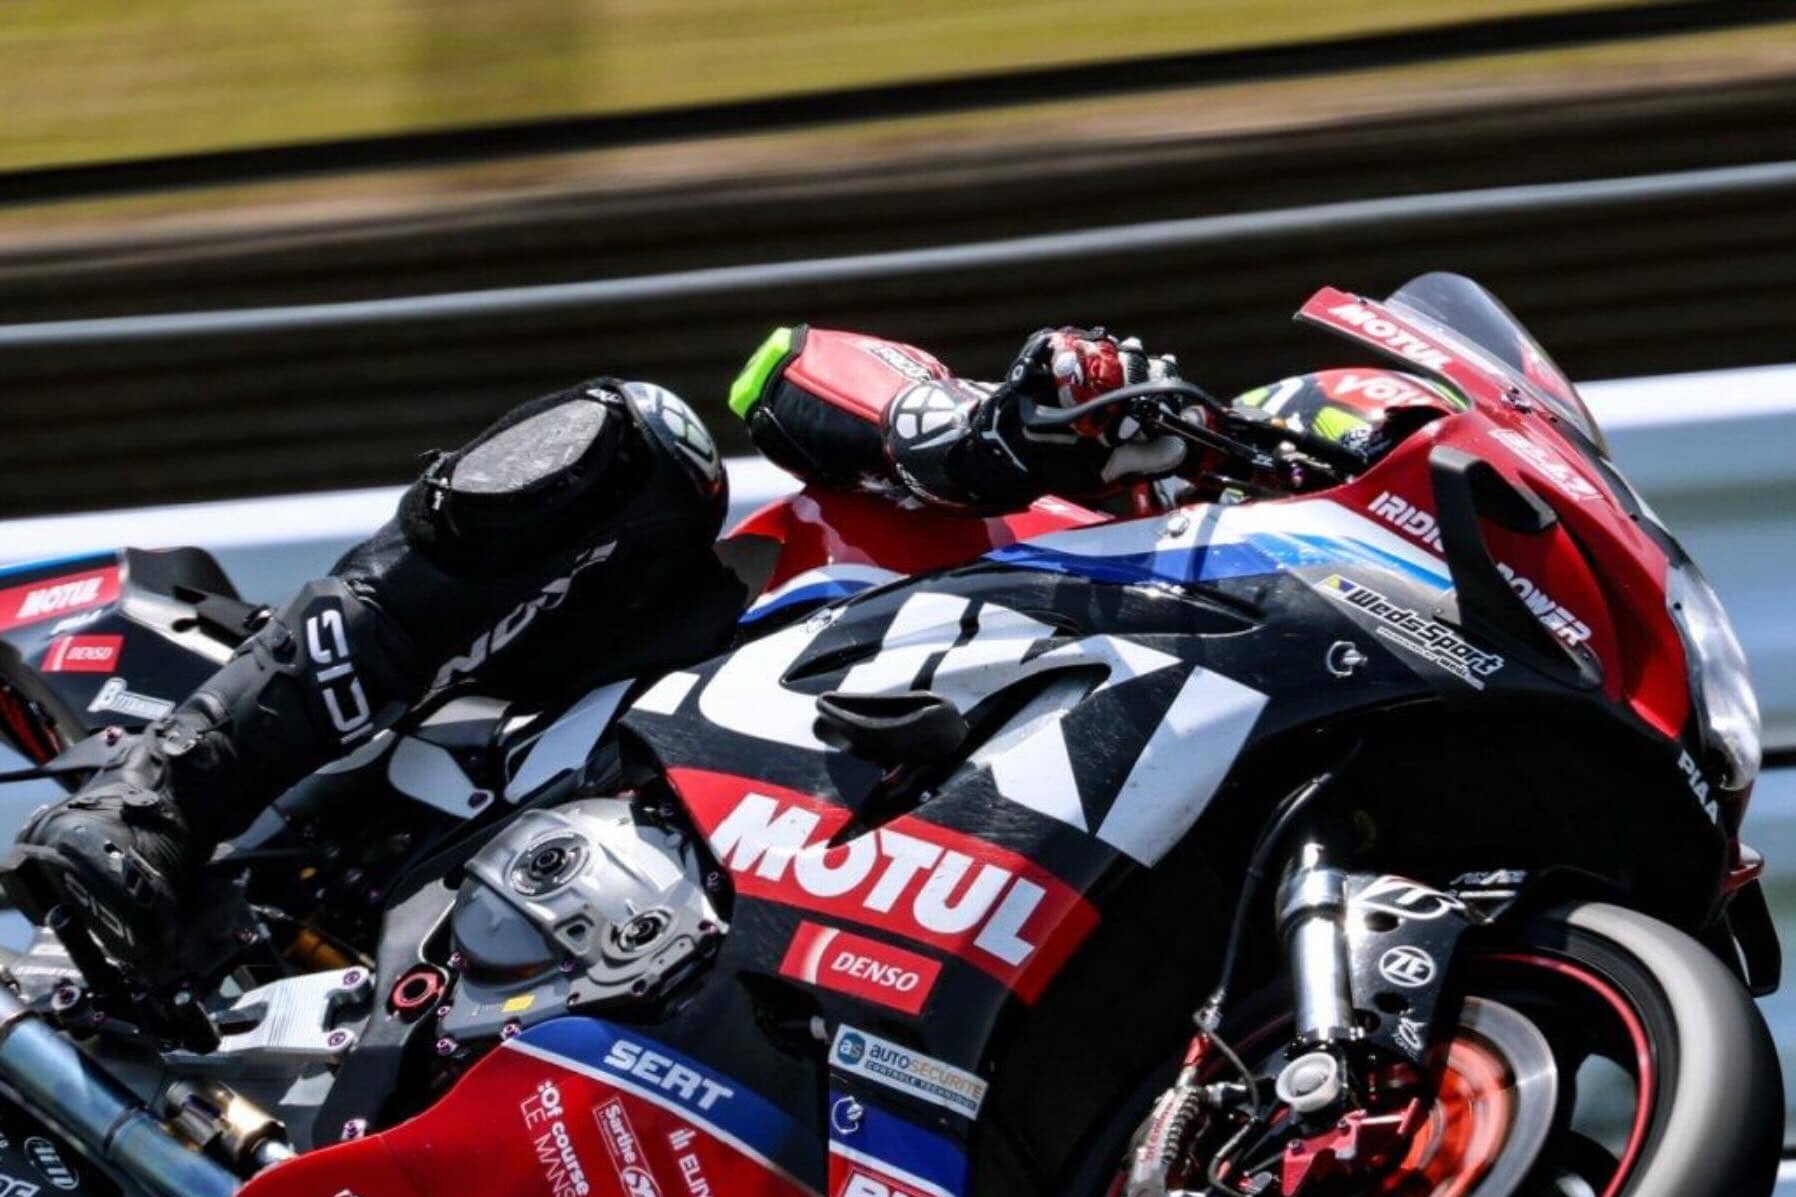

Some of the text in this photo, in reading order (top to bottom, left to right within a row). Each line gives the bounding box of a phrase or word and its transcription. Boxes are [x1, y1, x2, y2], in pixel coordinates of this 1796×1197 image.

[1328, 303, 1452, 371] MOTUL
[306, 608, 373, 743] SIDI
[710, 792, 1046, 967] MOTUL
[832, 952, 919, 992] DENSO
[1381, 947, 1434, 986] ZF
[603, 1040, 734, 1110] SERT
[520, 1095, 546, 1131] LE
[605, 1104, 636, 1164] Sarthe
[552, 1122, 590, 1197] course
